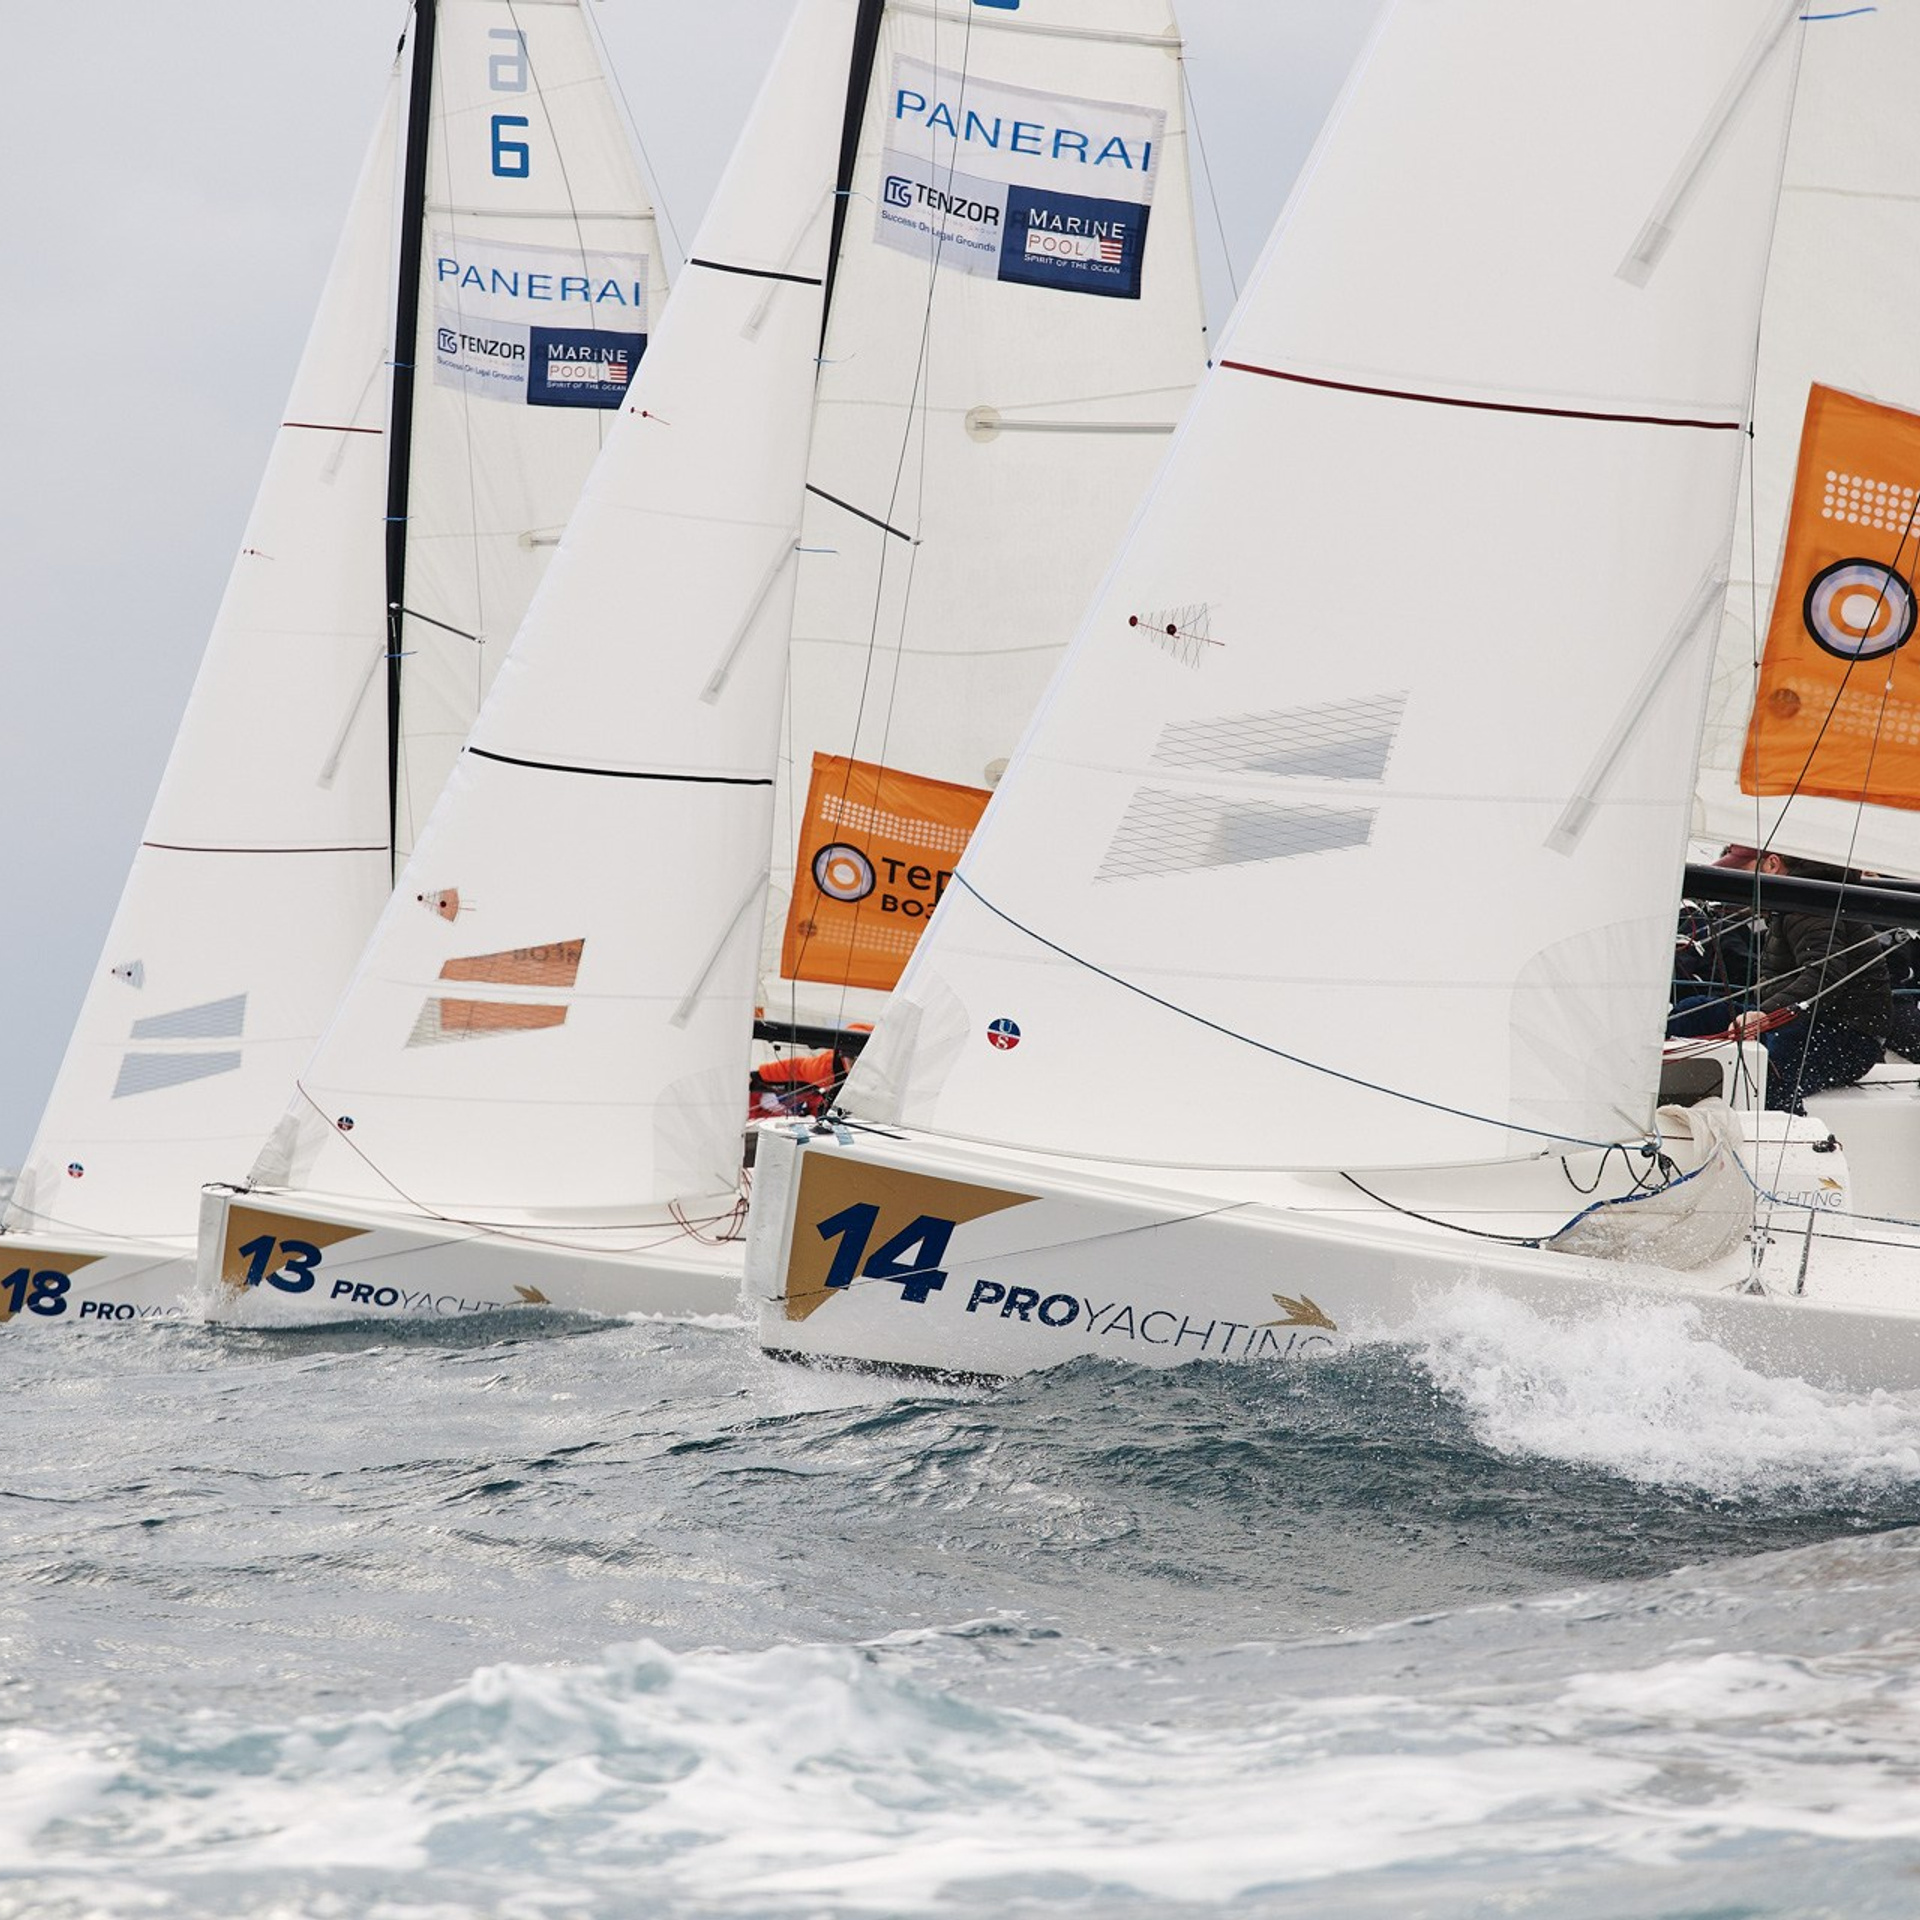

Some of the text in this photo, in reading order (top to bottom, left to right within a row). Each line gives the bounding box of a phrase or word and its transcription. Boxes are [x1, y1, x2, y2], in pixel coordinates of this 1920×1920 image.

[491, 115, 529, 178] 6
[896, 89, 1152, 171] PANERAI
[915, 184, 999, 226] TENZOR
[1028, 208, 1126, 239] MARINE
[881, 210, 916, 229] Success
[919, 222, 930, 233] On
[932, 227, 954, 241] Legal
[956, 235, 996, 253] Grounds
[1028, 234, 1083, 256] POOL
[438, 258, 640, 306] PANERAI
[1024, 254, 1053, 264] SPIRIT
[1071, 261, 1088, 270] THE
[1090, 263, 1120, 274] OCEAN
[459, 334, 525, 361] TENZOR
[547, 344, 628, 362] MARINE
[549, 364, 596, 379] POOL
[239, 1235, 322, 1294] 13
[816, 1201, 957, 1304] 14
[1, 1268, 71, 1316] 18
